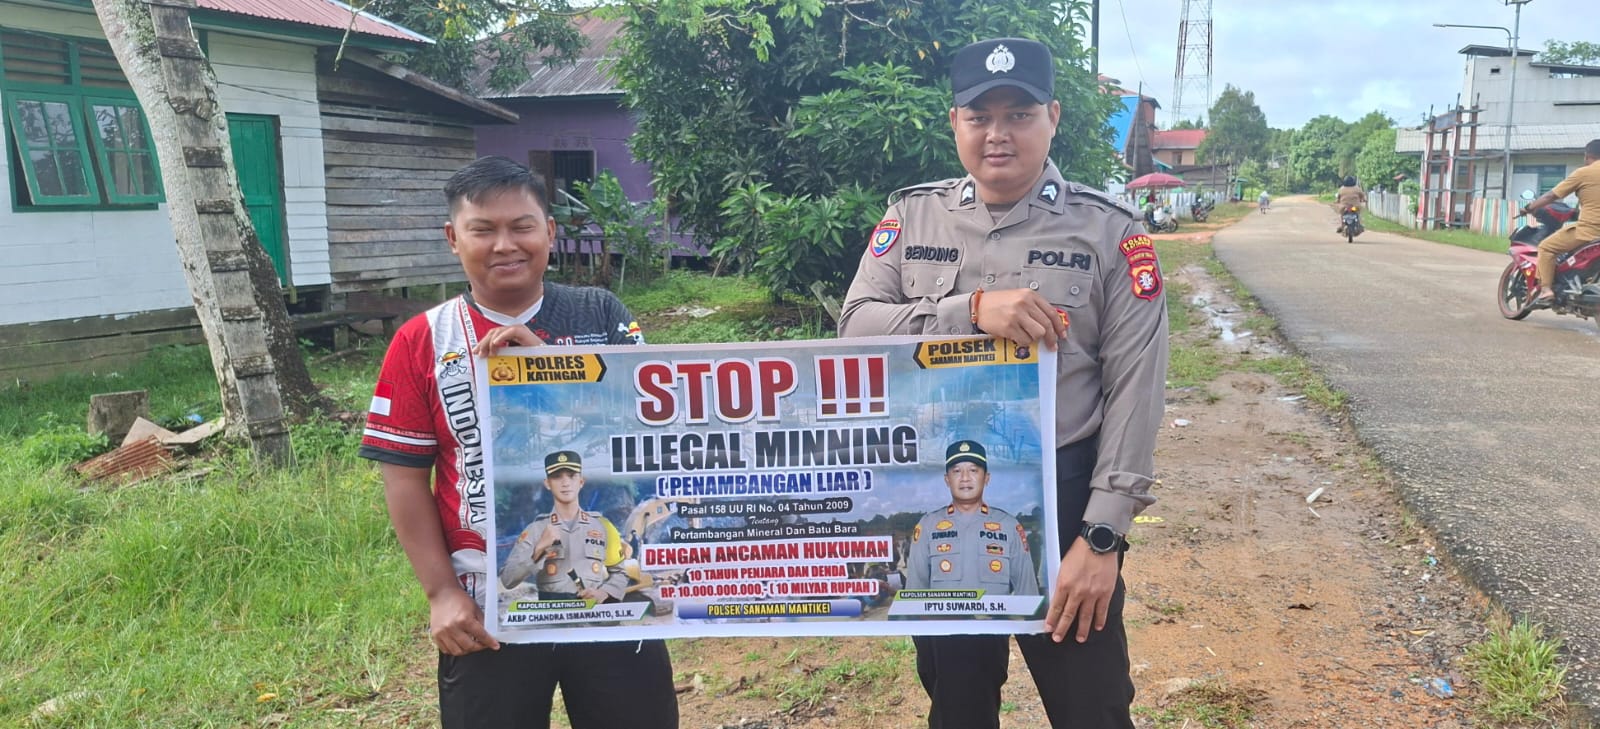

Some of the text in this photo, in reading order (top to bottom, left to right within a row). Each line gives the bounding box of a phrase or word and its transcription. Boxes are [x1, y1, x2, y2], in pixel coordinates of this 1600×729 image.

[1028, 250, 1092, 271] POLRI
[928, 338, 996, 356] POLSEK
[525, 354, 586, 370] POLRES
[526, 370, 587, 382] KATINGAN
[636, 359, 796, 424] STOP
[611, 425, 919, 473] ILLEGAL MINNING
[669, 472, 812, 496] PENAMBANGAN
[816, 471, 860, 492] LIAR
[681, 500, 849, 515] Pasal 158 UU RI No. 04 Tahun 2009
[748, 515, 779, 526] Tentang
[673, 525, 858, 541] Pertambangan Mineral Dan Batu Bara
[980, 530, 1008, 542] POLRI
[645, 540, 889, 566] DENGAN ANCAMAN HUKUMAN
[690, 564, 847, 581] 10 TAHUN PENJARA DAN DENDA
[660, 587, 677, 598] RP.
[776, 583, 789, 594] 10
[791, 582, 828, 594] MILYAR
[831, 581, 870, 593] RUPIAH
[552, 600, 585, 608] KATINGAN
[708, 602, 831, 616] POLSEK SANAMAN MANTIKEI
[924, 602, 1007, 612] IPTU SUWARDI, S.H.
[507, 609, 635, 622] AKBP CHANDRA ISMAWANTO, S.I.K.
